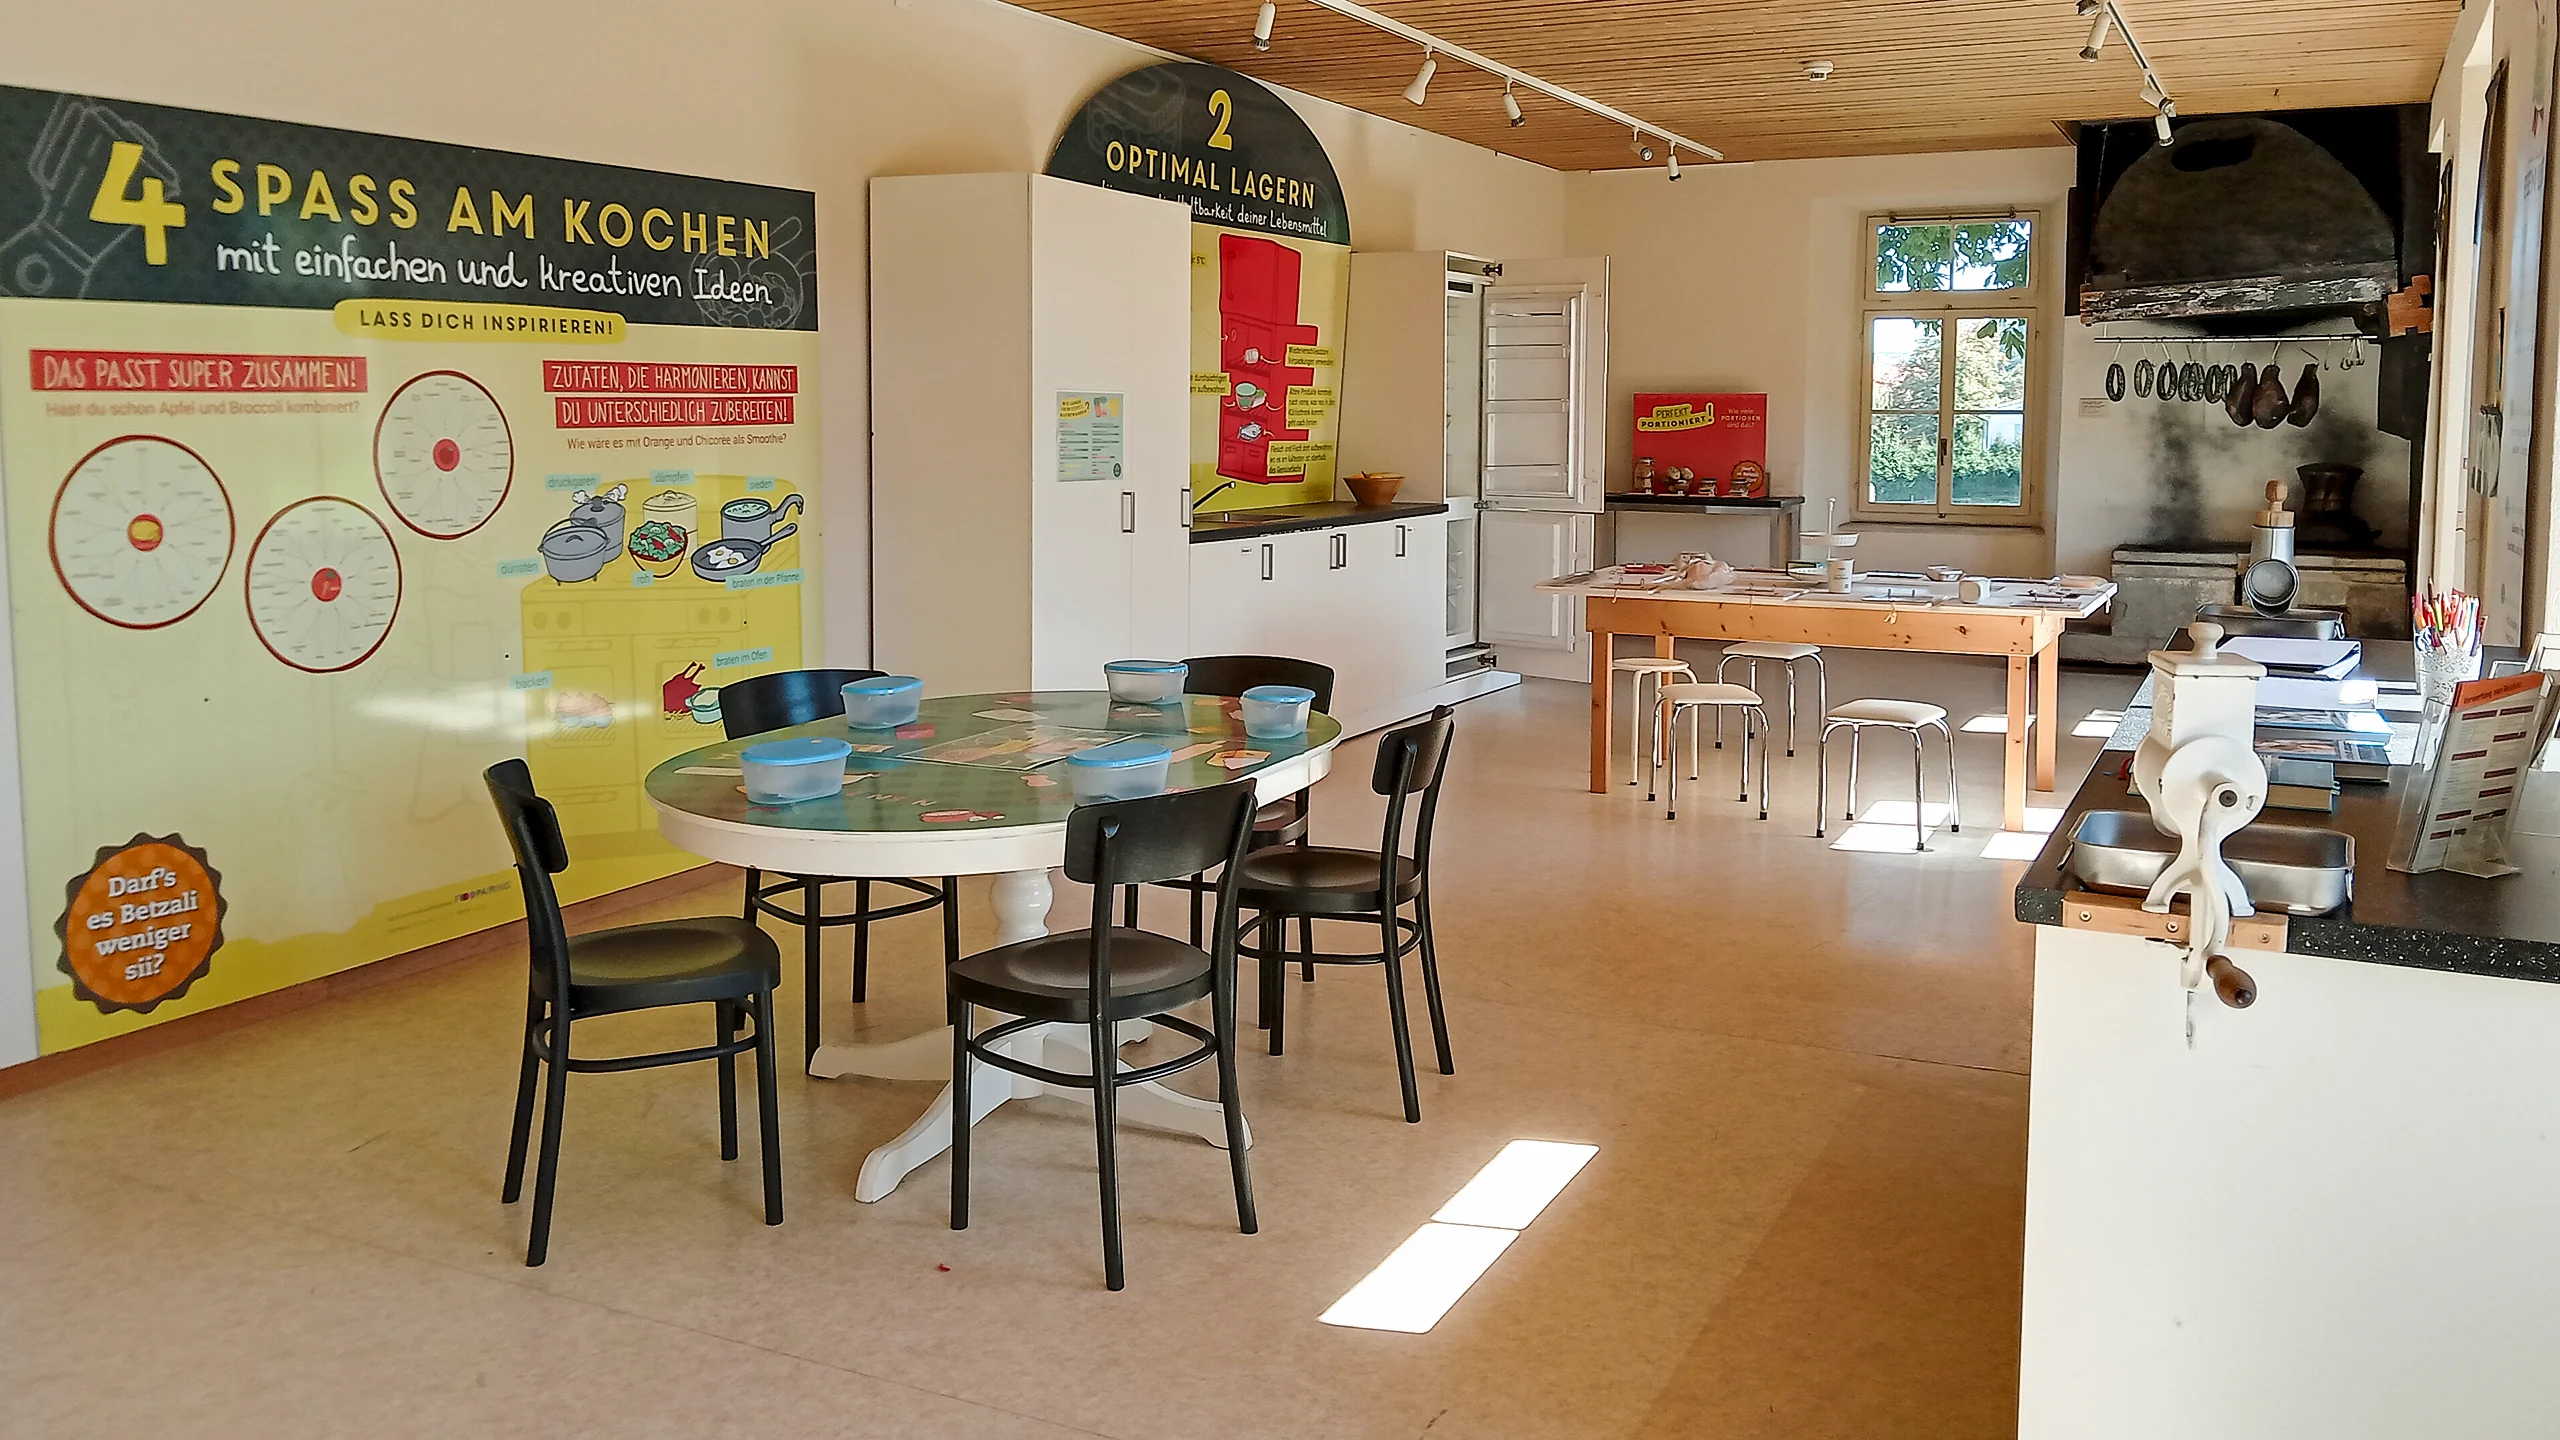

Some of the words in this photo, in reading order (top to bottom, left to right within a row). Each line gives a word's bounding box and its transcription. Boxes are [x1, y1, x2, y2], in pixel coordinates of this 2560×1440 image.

[1207, 89, 1233, 151] 2
[1106, 141, 1220, 191] OPTIMAL
[1231, 167, 1316, 209] LAGERN
[89, 140, 187, 266] 4
[211, 157, 418, 230] SPASS
[447, 186, 536, 240] AM
[564, 198, 769, 260] KOCHEN
[1237, 204, 1268, 226] deiner
[1269, 209, 1328, 238] Lebensmittel
[216, 231, 281, 275] mit
[295, 234, 447, 284] einfachen
[457, 251, 528, 289] und
[540, 253, 682, 298] kreativen
[693, 268, 773, 305] Ideen
[360, 309, 412, 329] LASS
[422, 312, 474, 331] DICH
[483, 315, 613, 336] INSPIRIEREN!
[43, 355, 86, 389] DAS
[95, 358, 161, 389] PASST
[168, 359, 233, 389] SUPER
[240, 360, 358, 389] ZUSAMMEN!
[551, 365, 623, 392] ZUTATEN,
[628, 366, 649, 389] DIE
[655, 366, 750, 393] HARMONIEREN,
[752, 368, 794, 391] KANNST
[86, 401, 106, 417] du
[110, 401, 155, 417] schon
[159, 400, 196, 418] Apfel
[229, 400, 283, 415] Broccoli
[562, 401, 581, 424] DU
[588, 401, 705, 424] UNTERSCHIEDLICH
[711, 399, 787, 423] ZUBEREITEN!
[1655, 408, 1689, 419] PERFEKT
[567, 438, 585, 450] Wie
[588, 437, 611, 449] wäre
[613, 440, 624, 449] es
[626, 437, 641, 448] mit
[643, 436, 674, 450] Orange
[677, 436, 693, 447] und
[733, 434, 745, 445] als
[746, 433, 788, 446] Smoothie?
[732, 579, 755, 590] braten
[756, 578, 763, 586] in
[764, 576, 775, 585] der
[776, 572, 800, 583] Pfanne
[716, 655, 739, 667] braten
[740, 653, 750, 664] im
[751, 650, 768, 662] Ofen
[515, 675, 548, 689] backen
[107, 866, 177, 898] Darf's
[86, 910, 115, 930] es
[120, 890, 199, 925] Betzali
[95, 922, 192, 957] weniger
[124, 953, 165, 981] sii?
